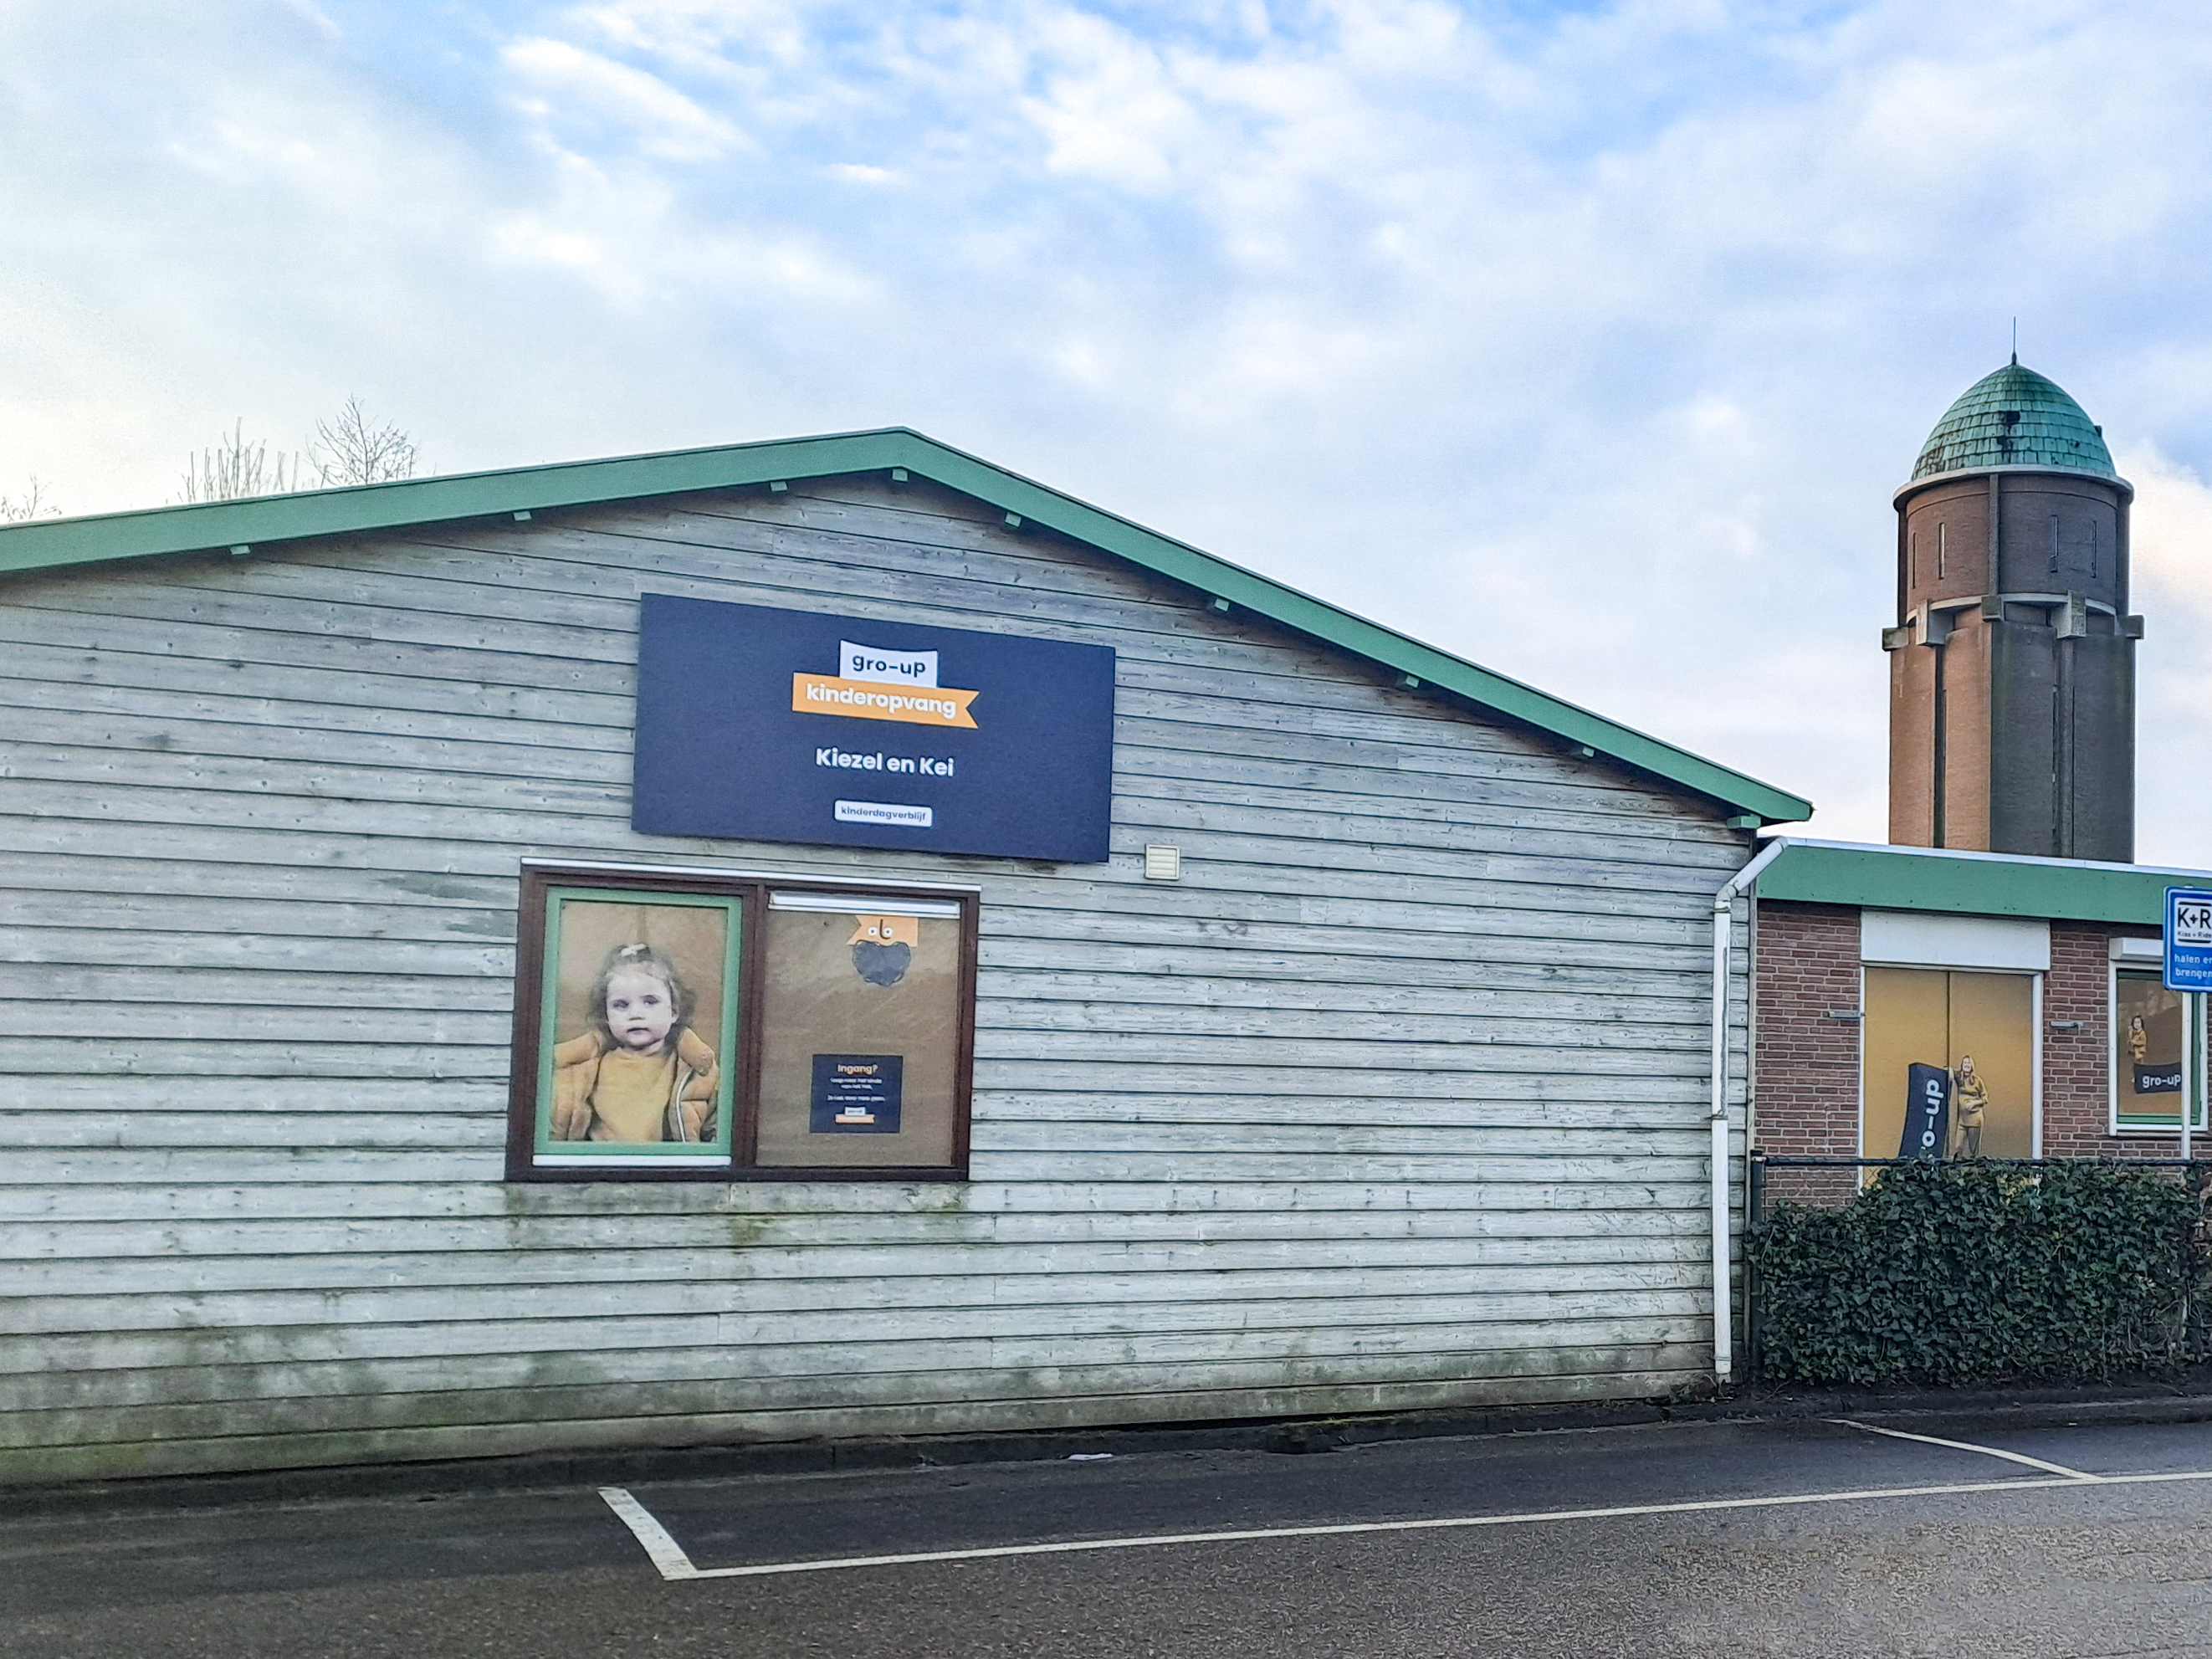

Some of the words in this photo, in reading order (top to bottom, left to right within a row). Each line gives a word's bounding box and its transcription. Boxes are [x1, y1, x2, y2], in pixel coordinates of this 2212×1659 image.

[852, 654, 926, 678] gro-up
[806, 683, 957, 719] kinderopvang
[816, 747, 883, 771] Kiezel
[887, 757, 914, 774] en
[919, 757, 955, 777] Kei
[841, 806, 926, 822] kinderdagverblijf
[2177, 907, 2212, 929] K+R
[2174, 953, 2200, 965] halen
[2175, 967, 2212, 981] brengen
[837, 1063, 878, 1075] Ingang?
[2142, 1074, 2181, 1088] gro-up
[1922, 1078, 1944, 1148] o-up
